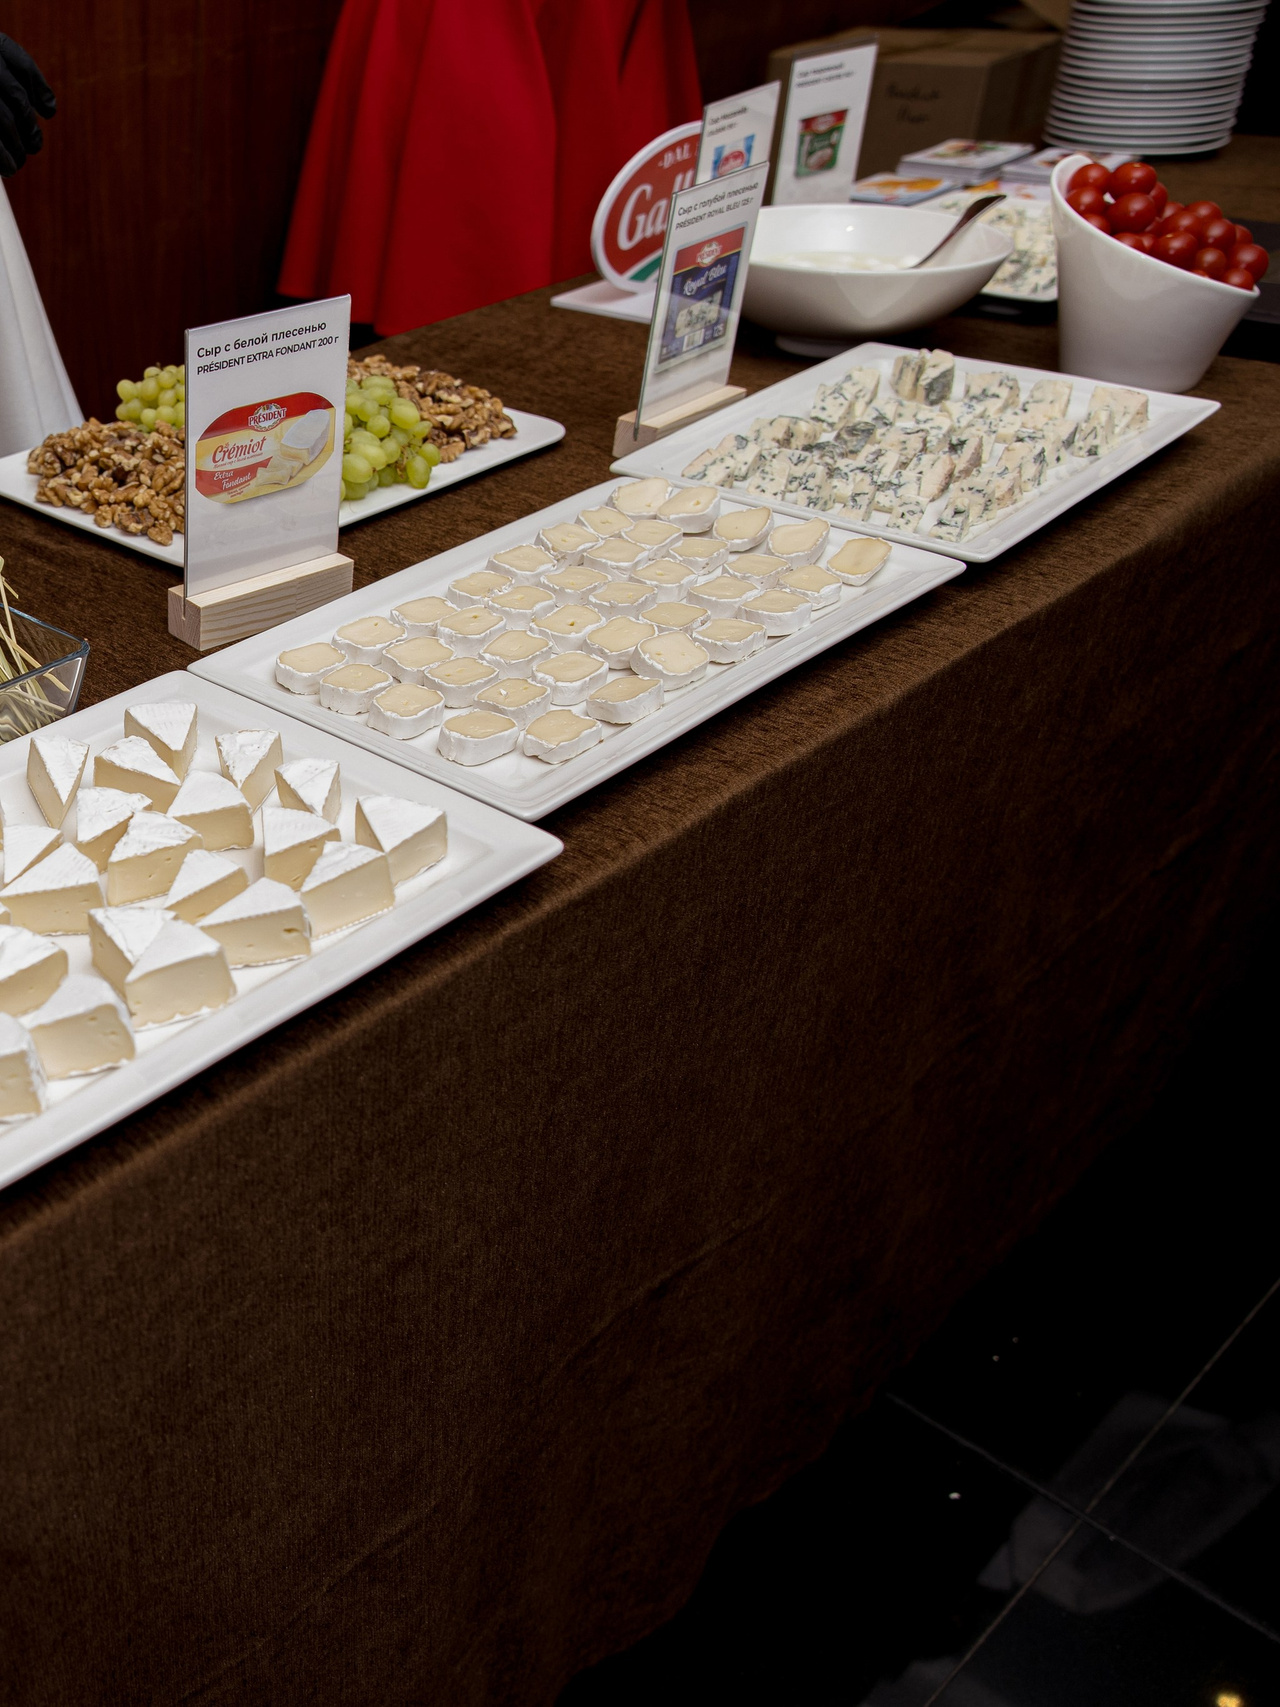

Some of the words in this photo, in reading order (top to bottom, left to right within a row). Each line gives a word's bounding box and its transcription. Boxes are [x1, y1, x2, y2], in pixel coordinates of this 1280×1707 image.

[677, 205, 692, 217] Сыр
[693, 203, 699, 211] с
[699, 192, 726, 208] голубой
[726, 182, 759, 197] плесенью
[675, 213, 707, 231] PRÉSIDENT
[707, 207, 725, 219] ROYAL
[726, 202, 740, 212] BLEU
[683, 271, 708, 296] Royal
[197, 346, 222, 359] Сыр
[226, 343, 231, 352] с
[233, 334, 269, 350] белой
[272, 321, 327, 342] плесенью
[197, 356, 246, 375] PRÉSIDENT
[247, 351, 274, 363] EXTRA
[275, 341, 317, 357] FONDANT
[318, 335, 334, 347] 200
[334, 336, 339, 344] г
[249, 408, 286, 426] PRÉSIDENT
[214, 471, 233, 480] Extra
[222, 473, 251, 490] Fondant
